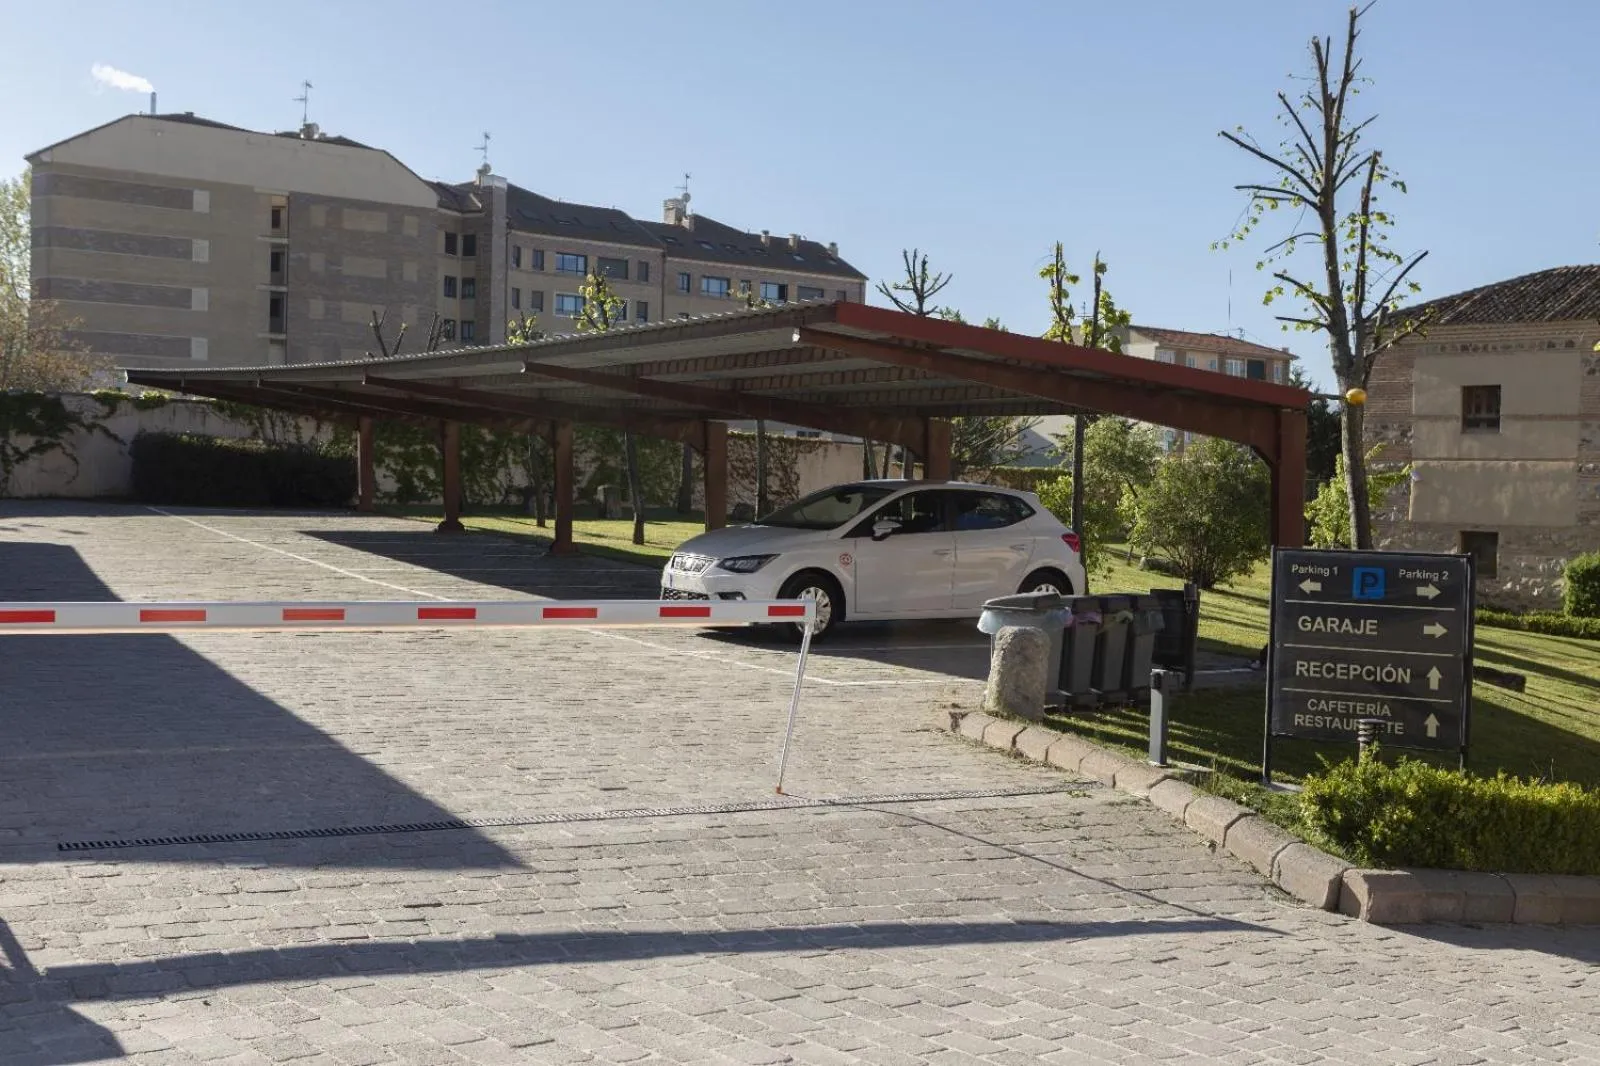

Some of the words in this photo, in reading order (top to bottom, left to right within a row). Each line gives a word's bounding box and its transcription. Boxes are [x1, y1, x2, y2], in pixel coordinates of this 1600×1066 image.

[1291, 564, 1330, 577] Parking
[1333, 566, 1338, 576] 1
[1399, 569, 1439, 582] Parking
[1442, 571, 1449, 581] 2
[1360, 572, 1380, 595] P
[1298, 615, 1378, 635] GARAJE
[1295, 660, 1411, 684] RECEPCIÓN
[1307, 698, 1392, 717] CAFETERÍA
[1294, 714, 1405, 735] RESTAURTE
